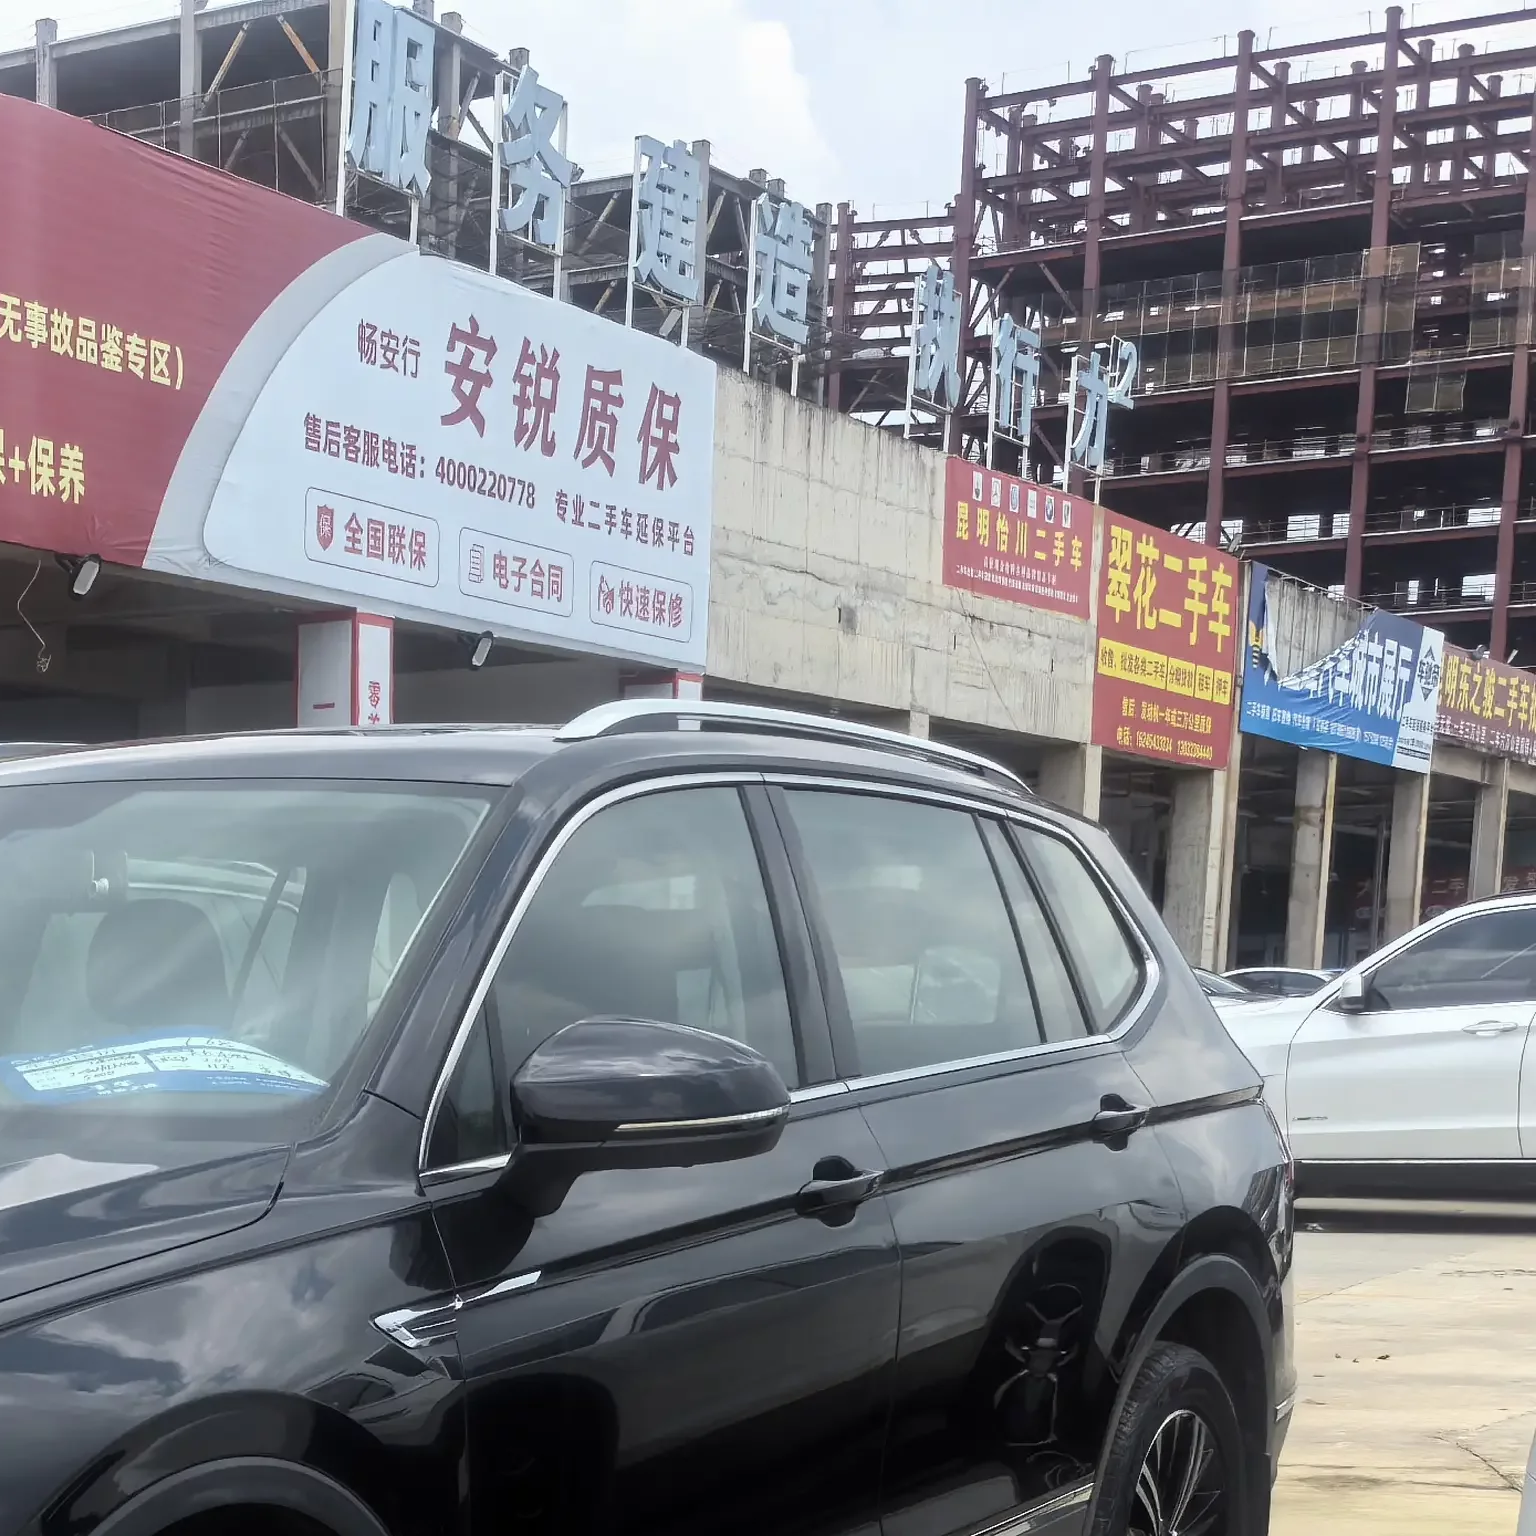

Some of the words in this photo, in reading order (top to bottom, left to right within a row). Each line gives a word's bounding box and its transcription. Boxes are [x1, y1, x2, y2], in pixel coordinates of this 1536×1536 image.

[357, 319, 421, 378] 畅安行
[440, 314, 682, 490] 安锐质保
[344, 512, 426, 571] 全国联保
[555, 490, 695, 556] 专业二手车延保平台
[493, 550, 563, 603] 电子合同
[618, 579, 684, 628] 快速保修
[1105, 523, 1233, 653] 翠花二手车
